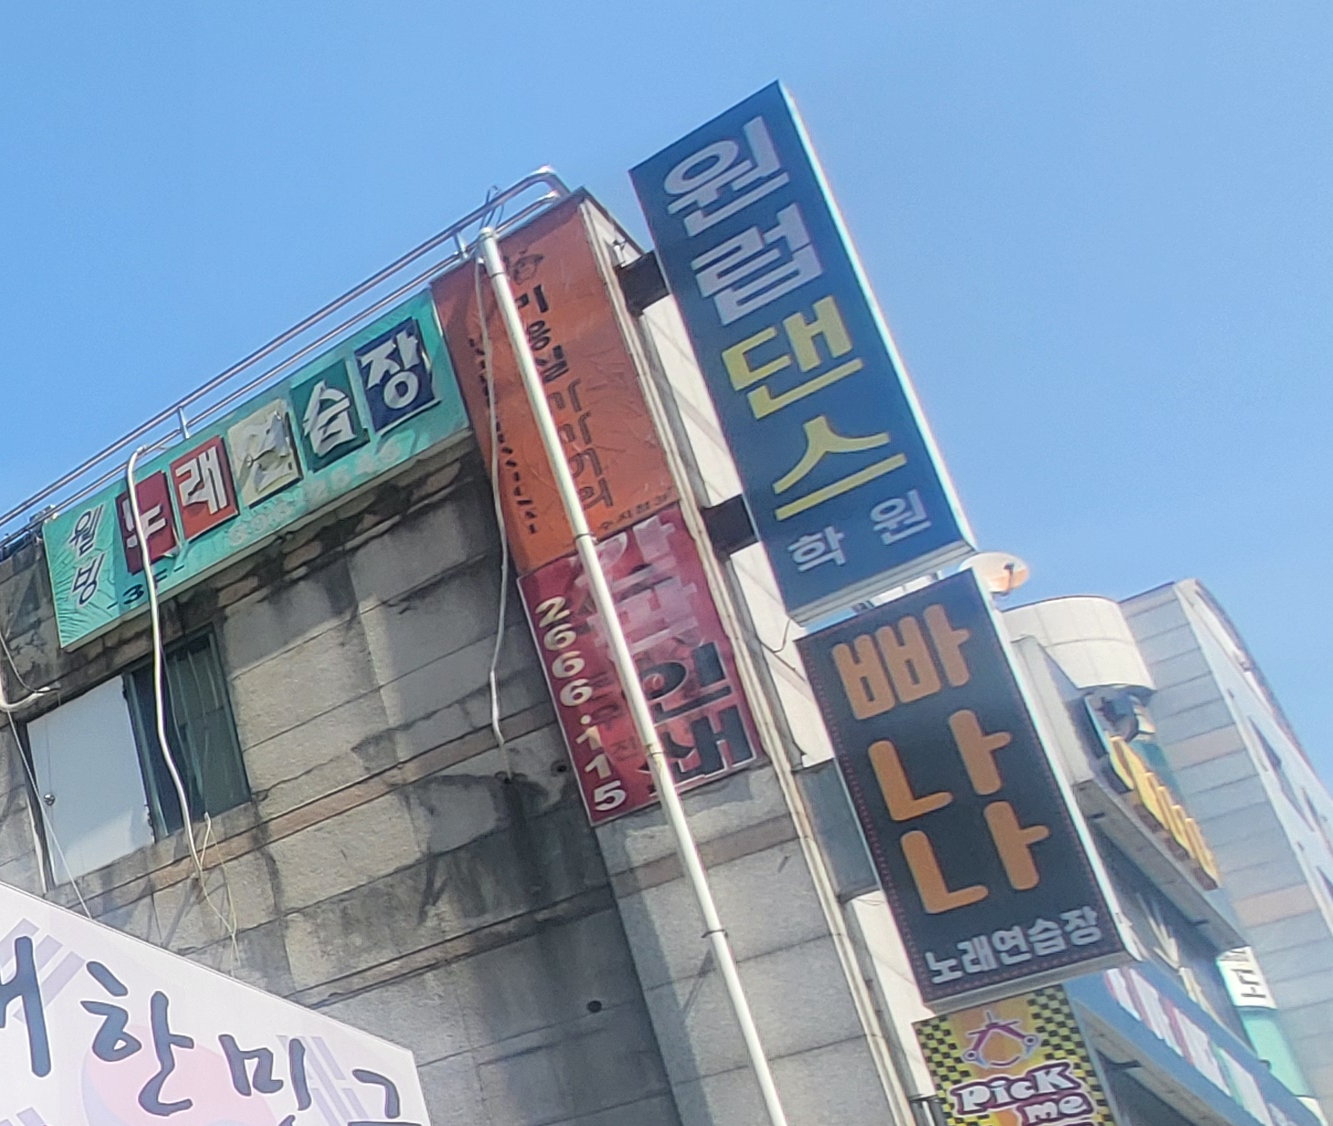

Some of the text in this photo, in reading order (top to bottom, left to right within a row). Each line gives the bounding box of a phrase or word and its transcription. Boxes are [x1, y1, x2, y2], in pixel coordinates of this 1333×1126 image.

[788, 489, 932, 574] 학원
[831, 603, 1051, 914] 빠나나
[925, 905, 1102, 984] 노래연습장
